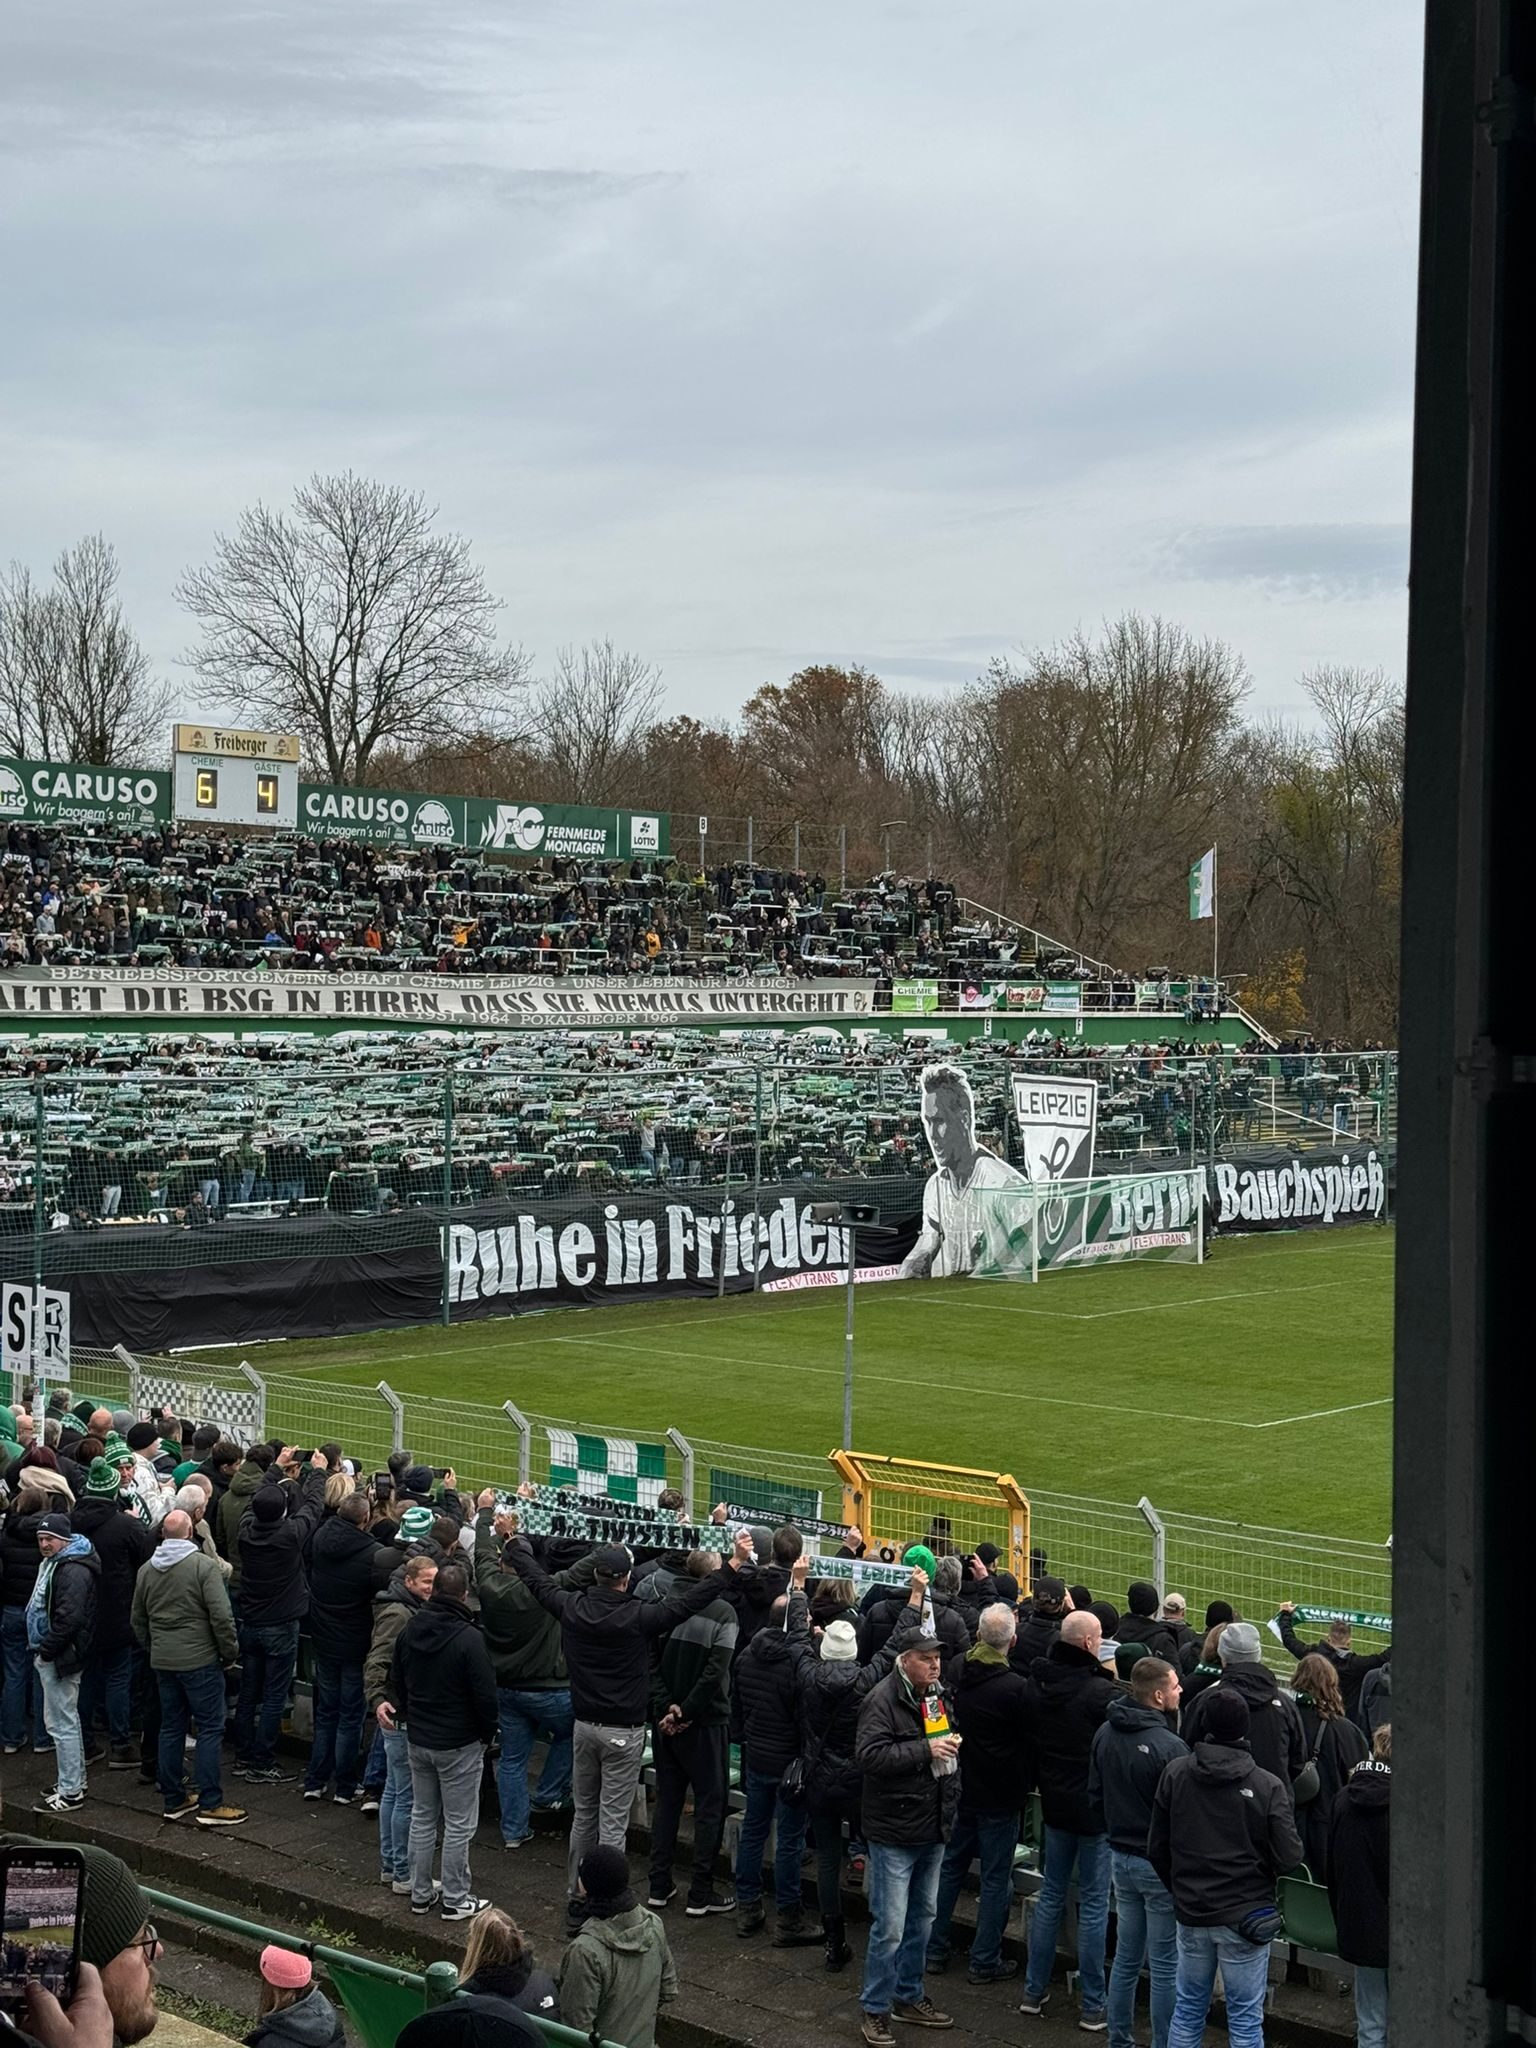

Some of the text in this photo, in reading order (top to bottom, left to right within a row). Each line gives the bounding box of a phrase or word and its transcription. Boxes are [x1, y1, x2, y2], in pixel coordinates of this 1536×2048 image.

[213, 731, 268, 757] Freiberger
[191, 756, 282, 773] CHEMIE GÄSTE
[31, 769, 158, 805] CARUSO
[197, 773, 273, 808] 6 4
[33, 801, 55, 816] Wir
[58, 801, 114, 822] baggern's
[117, 808, 135, 821] an!
[306, 792, 409, 823] CARUSO
[307, 820, 391, 839] Wir baggern's an!
[411, 824, 455, 837] CARUSO
[547, 825, 607, 842] FERNMELDE
[544, 840, 606, 855] MONTAGEN
[633, 836, 656, 847] LOTTO
[51, 967, 404, 986] BETRIEBSSPORTGEMEINSCHAFT
[410, 974, 484, 989] CHEMIE
[489, 975, 556, 989] LEIPZIG
[573, 976, 627, 989] UNSER
[633, 977, 684, 989] LEBEN
[688, 978, 721, 989] NUR
[760, 977, 796, 989] DICH
[122, 987, 189, 1011] DIE
[201, 988, 274, 1012] BSG
[286, 990, 321, 1012] IN
[460, 991, 538, 1013] DASS
[543, 993, 589, 1013] SIE
[593, 992, 704, 1013] NIEMALS
[708, 991, 849, 1013] UNTERGEHT
[897, 987, 933, 995] CHEMIE
[471, 1011, 510, 1025] 1964
[521, 1013, 638, 1025] POKALSIEGER
[642, 1012, 679, 1024] 1966
[1018, 1091, 1087, 1118] LEIPZIG
[1215, 1151, 1384, 1223] Bauchspieß
[440, 1198, 850, 1304] Ruhe in Frieden
[7, 1291, 26, 1353] S
[1301, 1608, 1358, 1622] CHEMIE
